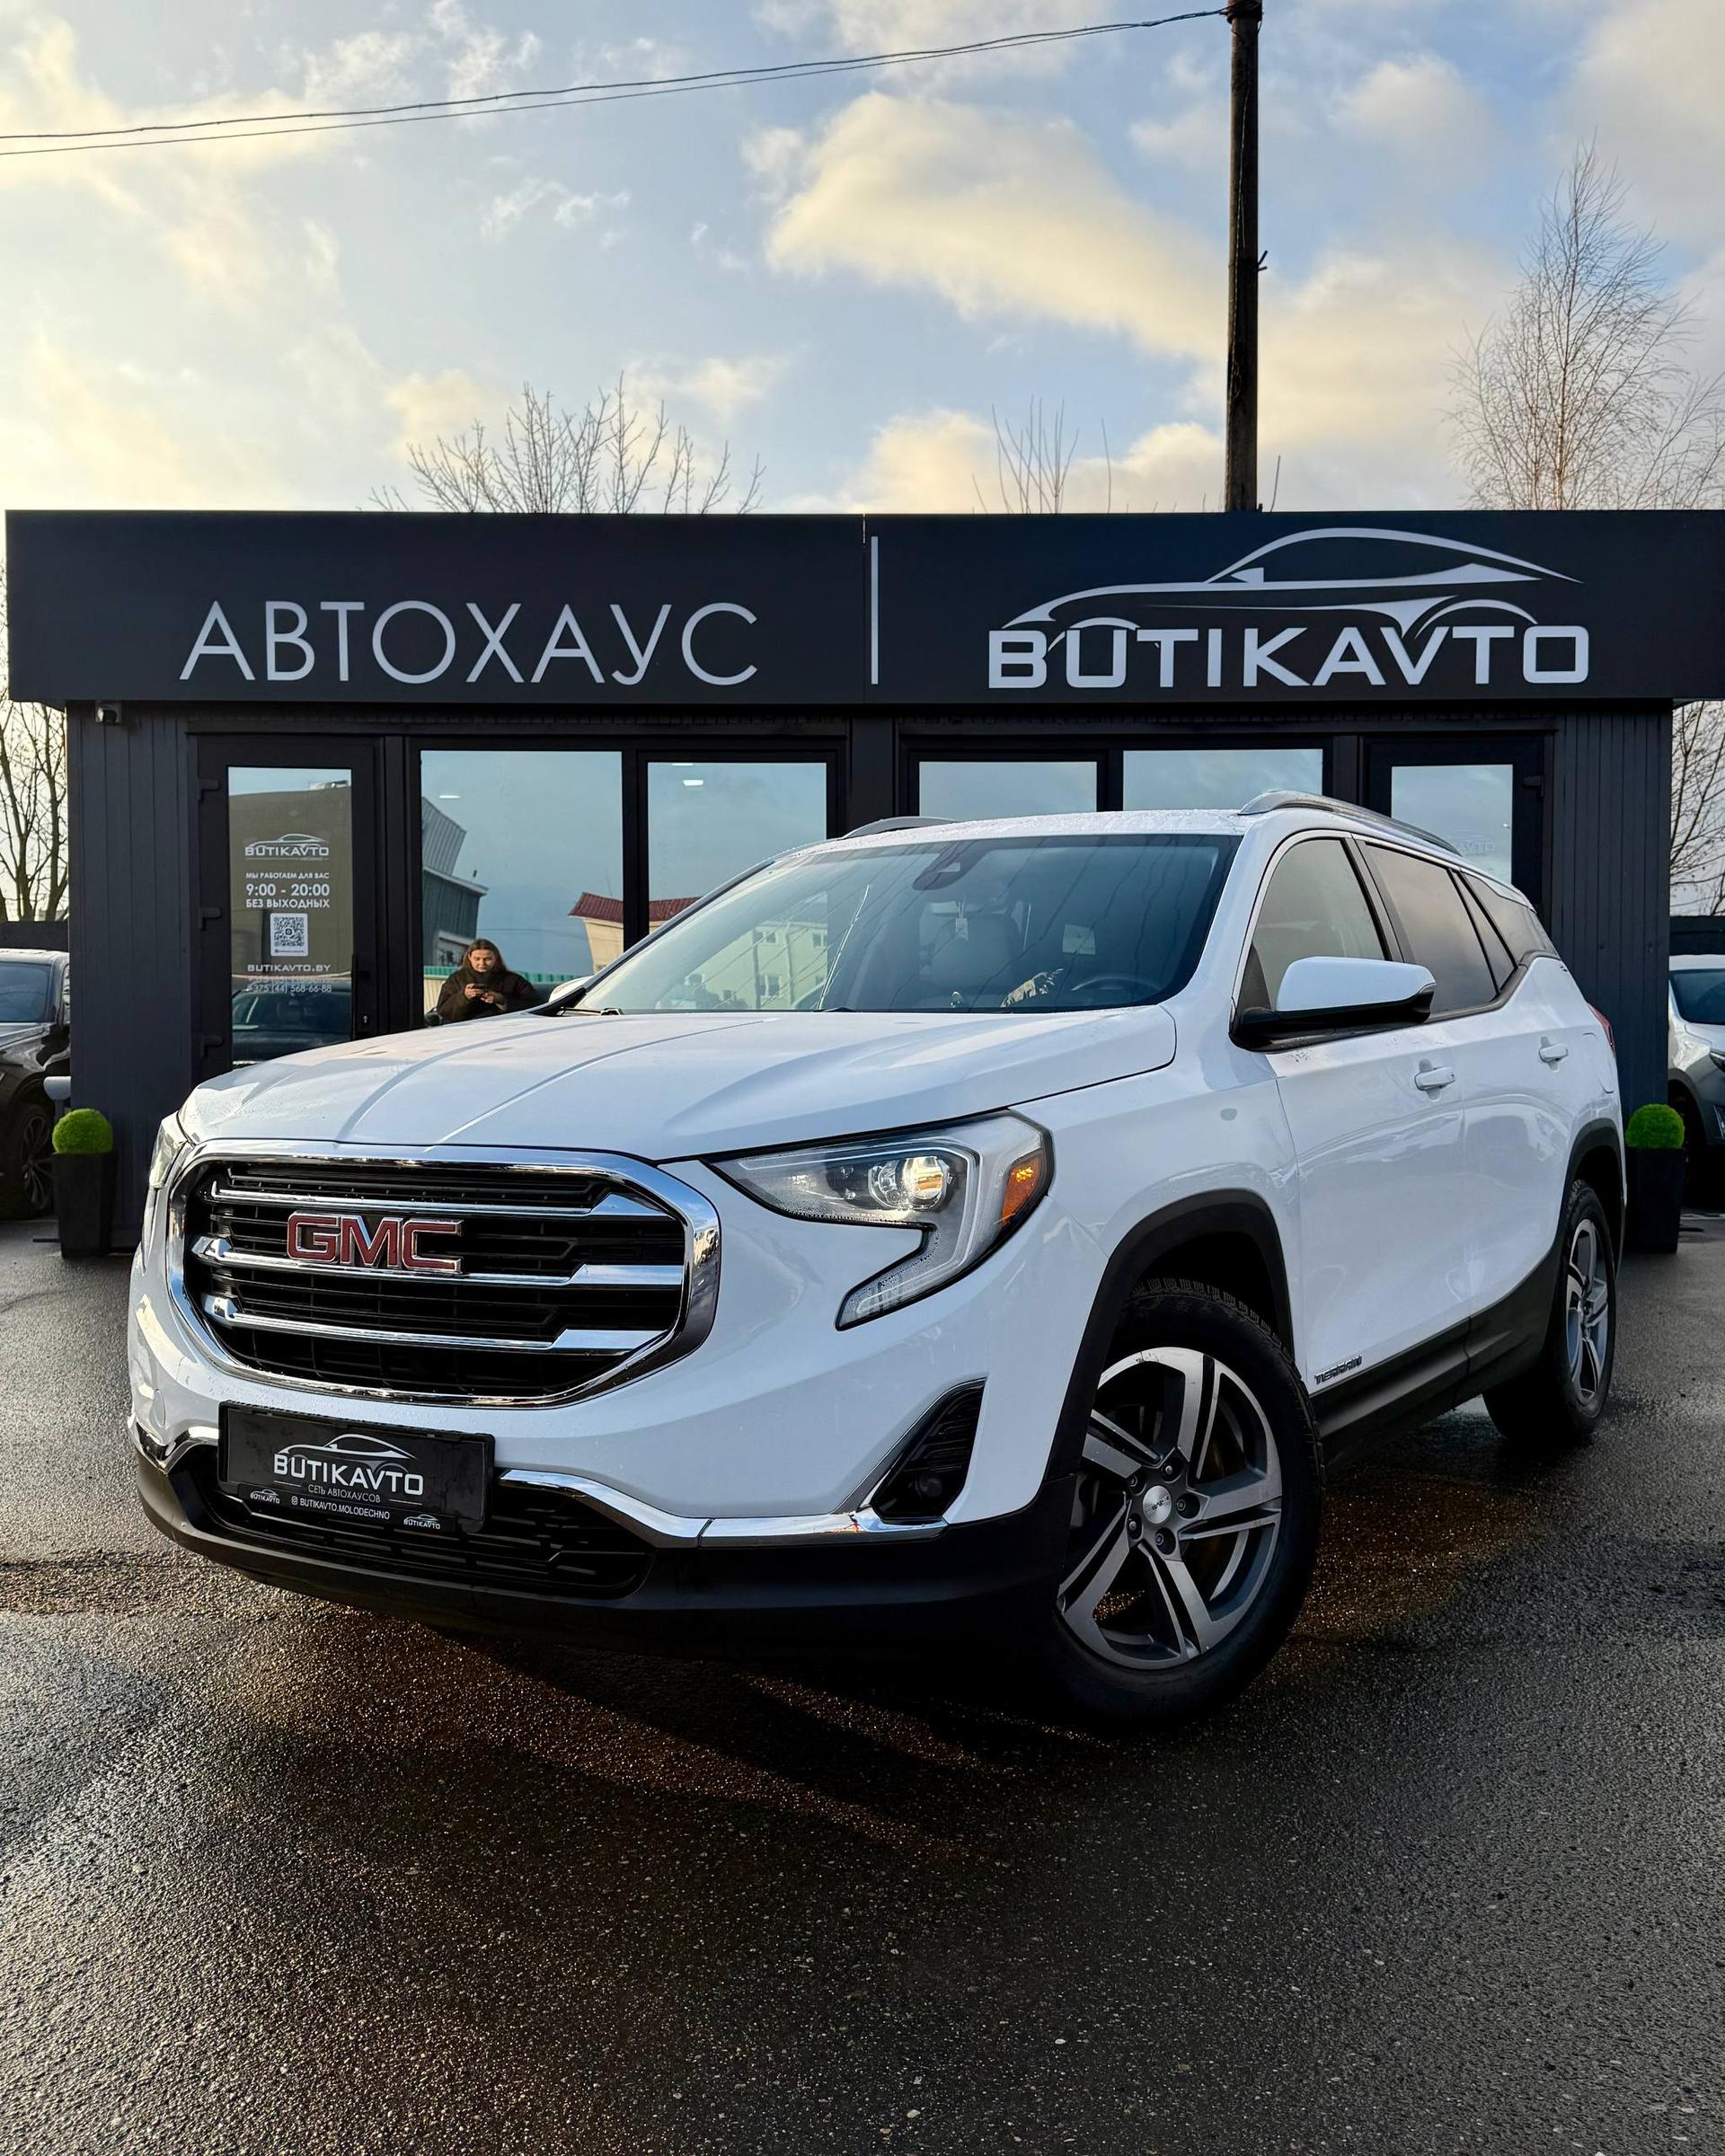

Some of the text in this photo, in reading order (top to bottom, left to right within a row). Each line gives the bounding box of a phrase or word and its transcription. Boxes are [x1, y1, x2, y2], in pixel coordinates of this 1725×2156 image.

[180, 600, 757, 685] АВТОХАУС
[987, 624, 1589, 689] BUTIKAVTO
[244, 846, 329, 856] BUTIKAVTO
[245, 883, 276, 897] 9:00
[291, 883, 331, 897] 20:00
[245, 898, 331, 909] БЕЗ ВЫХОДНЫХ
[247, 964, 332, 972] BUTIKAVTO.BY
[287, 1211, 464, 1274] GMC
[273, 1454, 424, 1496] BUTIKAVTO
[250, 1492, 280, 1505] BUTIKAVTO
[307, 1483, 381, 1503] СЕТЬ АВТОХАУСОВ
[299, 1498, 390, 1520] BUTIKAVTO.MOLODECHNO
[403, 1518, 441, 1530] BUTIKAVTO
